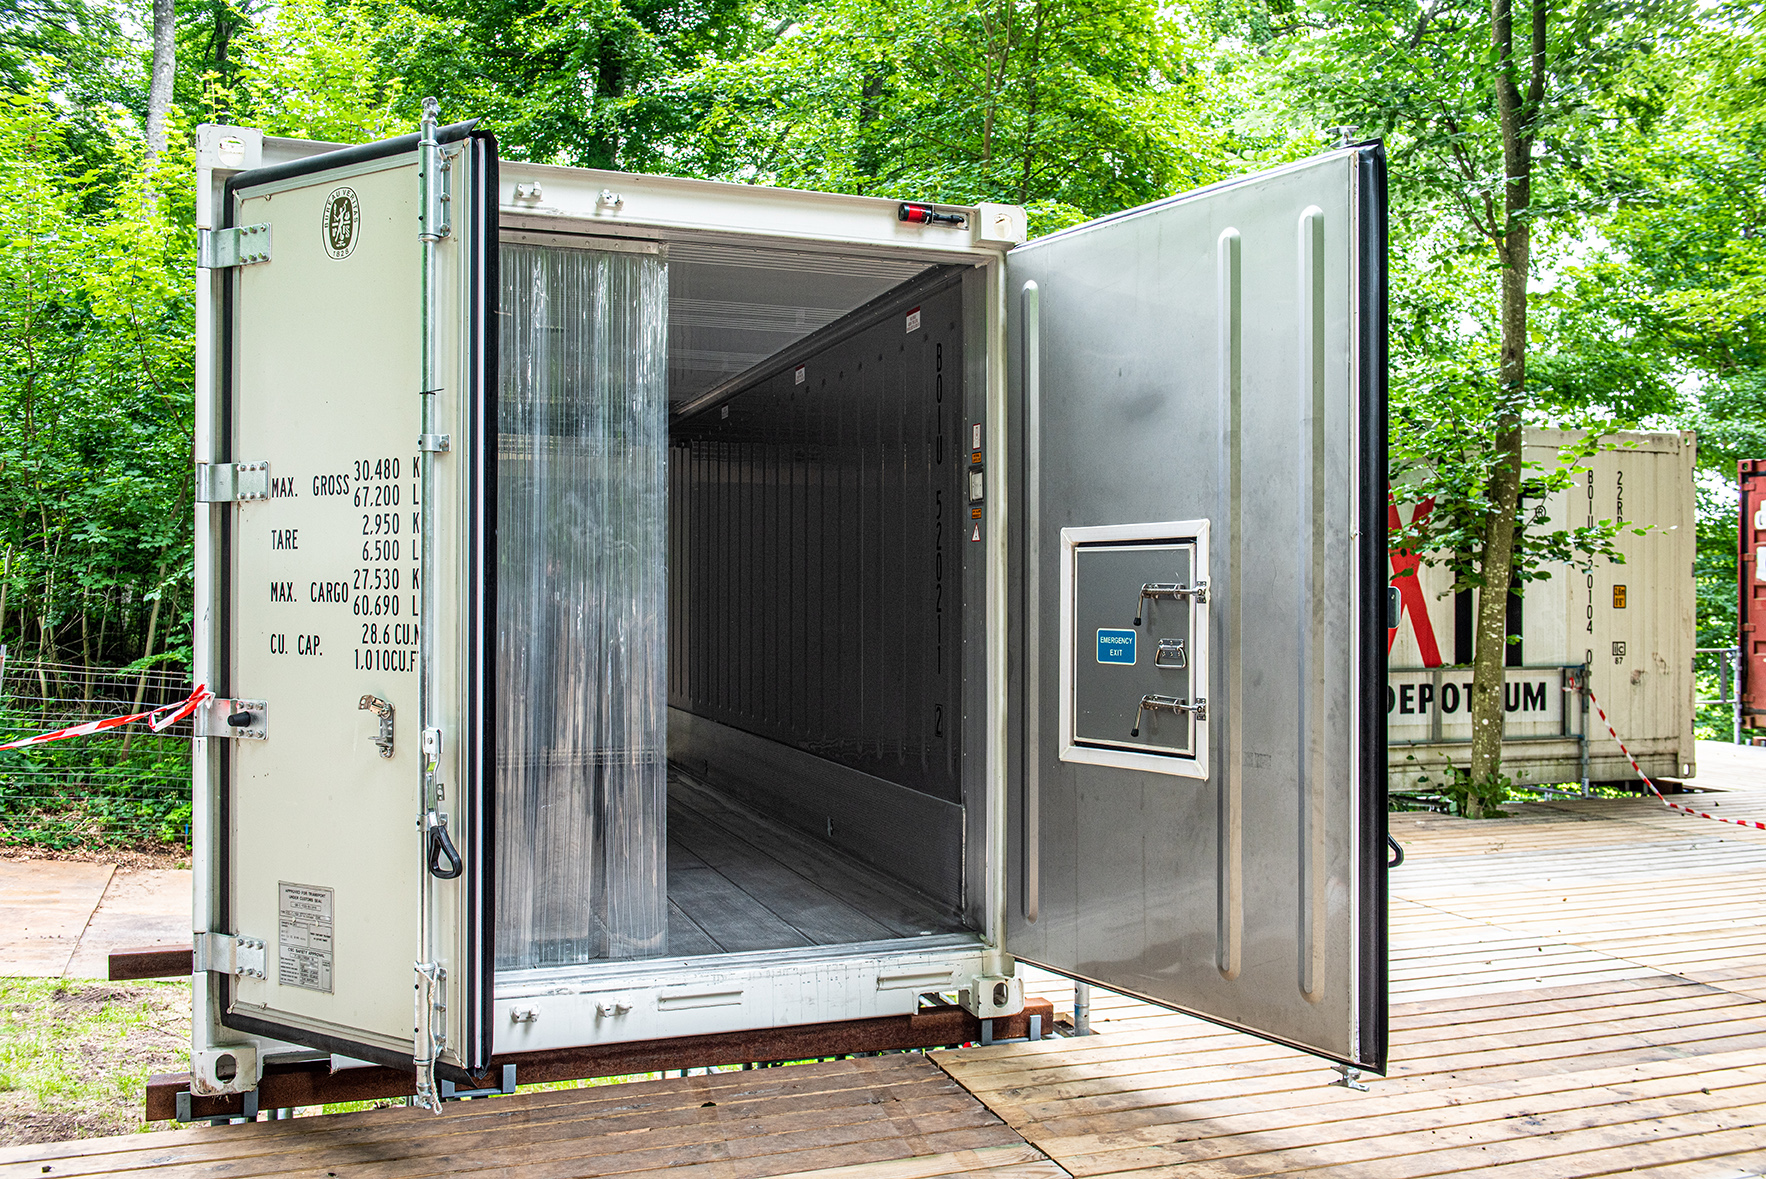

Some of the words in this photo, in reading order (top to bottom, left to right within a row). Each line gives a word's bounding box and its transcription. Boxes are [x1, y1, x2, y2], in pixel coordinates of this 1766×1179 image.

[354, 457, 400, 482] 30,480
[271, 477, 298, 499] MAX.
[312, 474, 350, 497] GROSS
[353, 484, 400, 508] 67,200
[362, 512, 400, 536] 2,950
[271, 529, 299, 550] TARE
[362, 539, 400, 562] 6,500
[353, 567, 400, 590] 27,530
[270, 581, 297, 603] MAX.
[310, 581, 349, 603] CARGO
[353, 594, 400, 617] 60,690
[270, 633, 288, 655] CU.
[297, 634, 323, 657] CAP.
[361, 622, 390, 645] 28.6
[1100, 636, 1133, 645] EMERGENCY
[936, 706, 942, 736] 2
